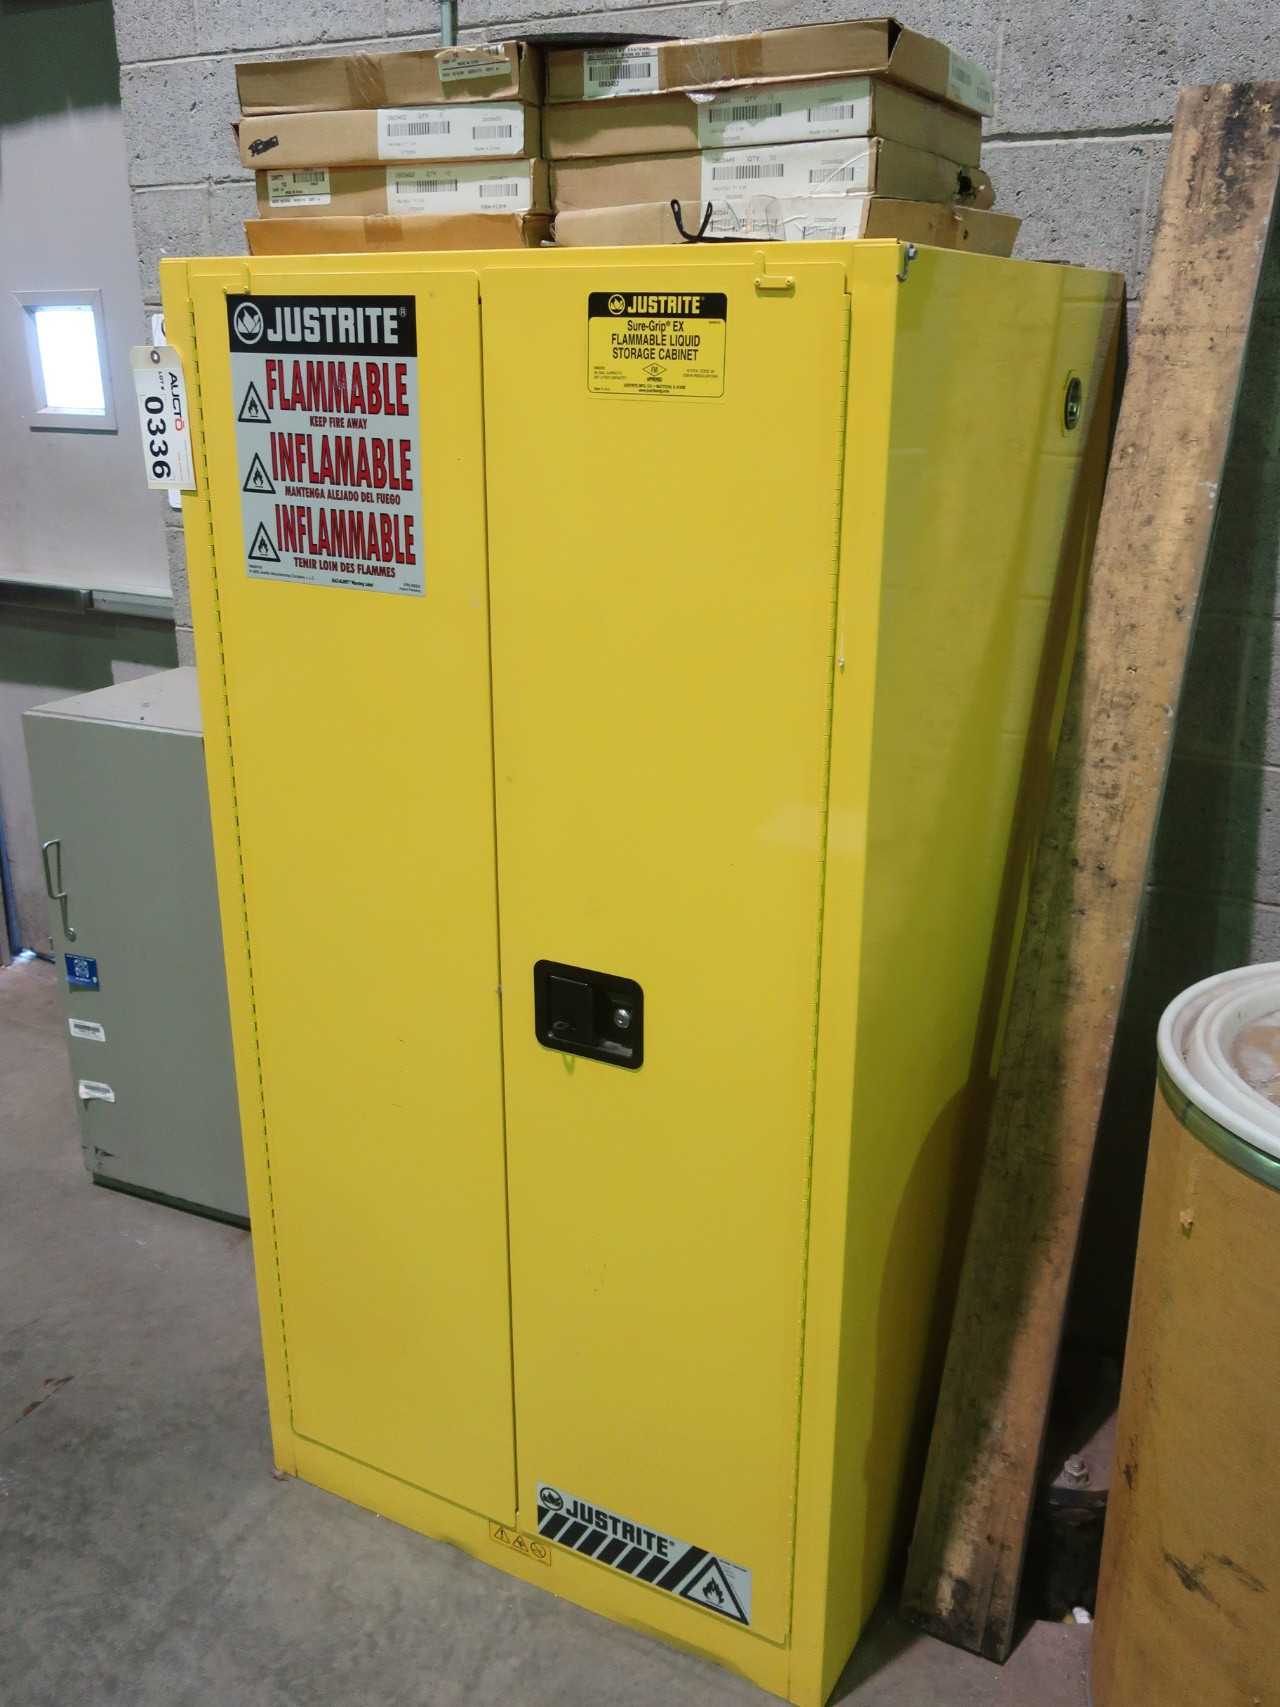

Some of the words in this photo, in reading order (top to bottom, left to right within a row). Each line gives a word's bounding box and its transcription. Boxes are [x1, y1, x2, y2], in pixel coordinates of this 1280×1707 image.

[673, 321, 684, 332] EX
[611, 333, 667, 346] FLAMMABLE
[670, 334, 701, 347] LIQUID
[612, 347, 656, 360] STORAGE
[658, 348, 699, 361] CABINET
[265, 359, 410, 417] FLAMMABLE
[309, 416, 328, 429] KEEP
[329, 417, 346, 430] FIRE
[346, 418, 368, 430] AWAY
[144, 395, 172, 479] 0336
[269, 431, 414, 491] INFLAMABLE
[284, 485, 326, 500] MANTENGA
[327, 488, 359, 503] ALEJADO
[360, 490, 375, 504] DEL
[376, 491, 401, 505] FUEGO
[274, 503, 417, 565] INFLAMMABLE
[293, 556, 317, 570] TENIR
[318, 559, 339, 572] LOIN
[340, 562, 355, 574] DES
[357, 563, 396, 578] FLAMMES
